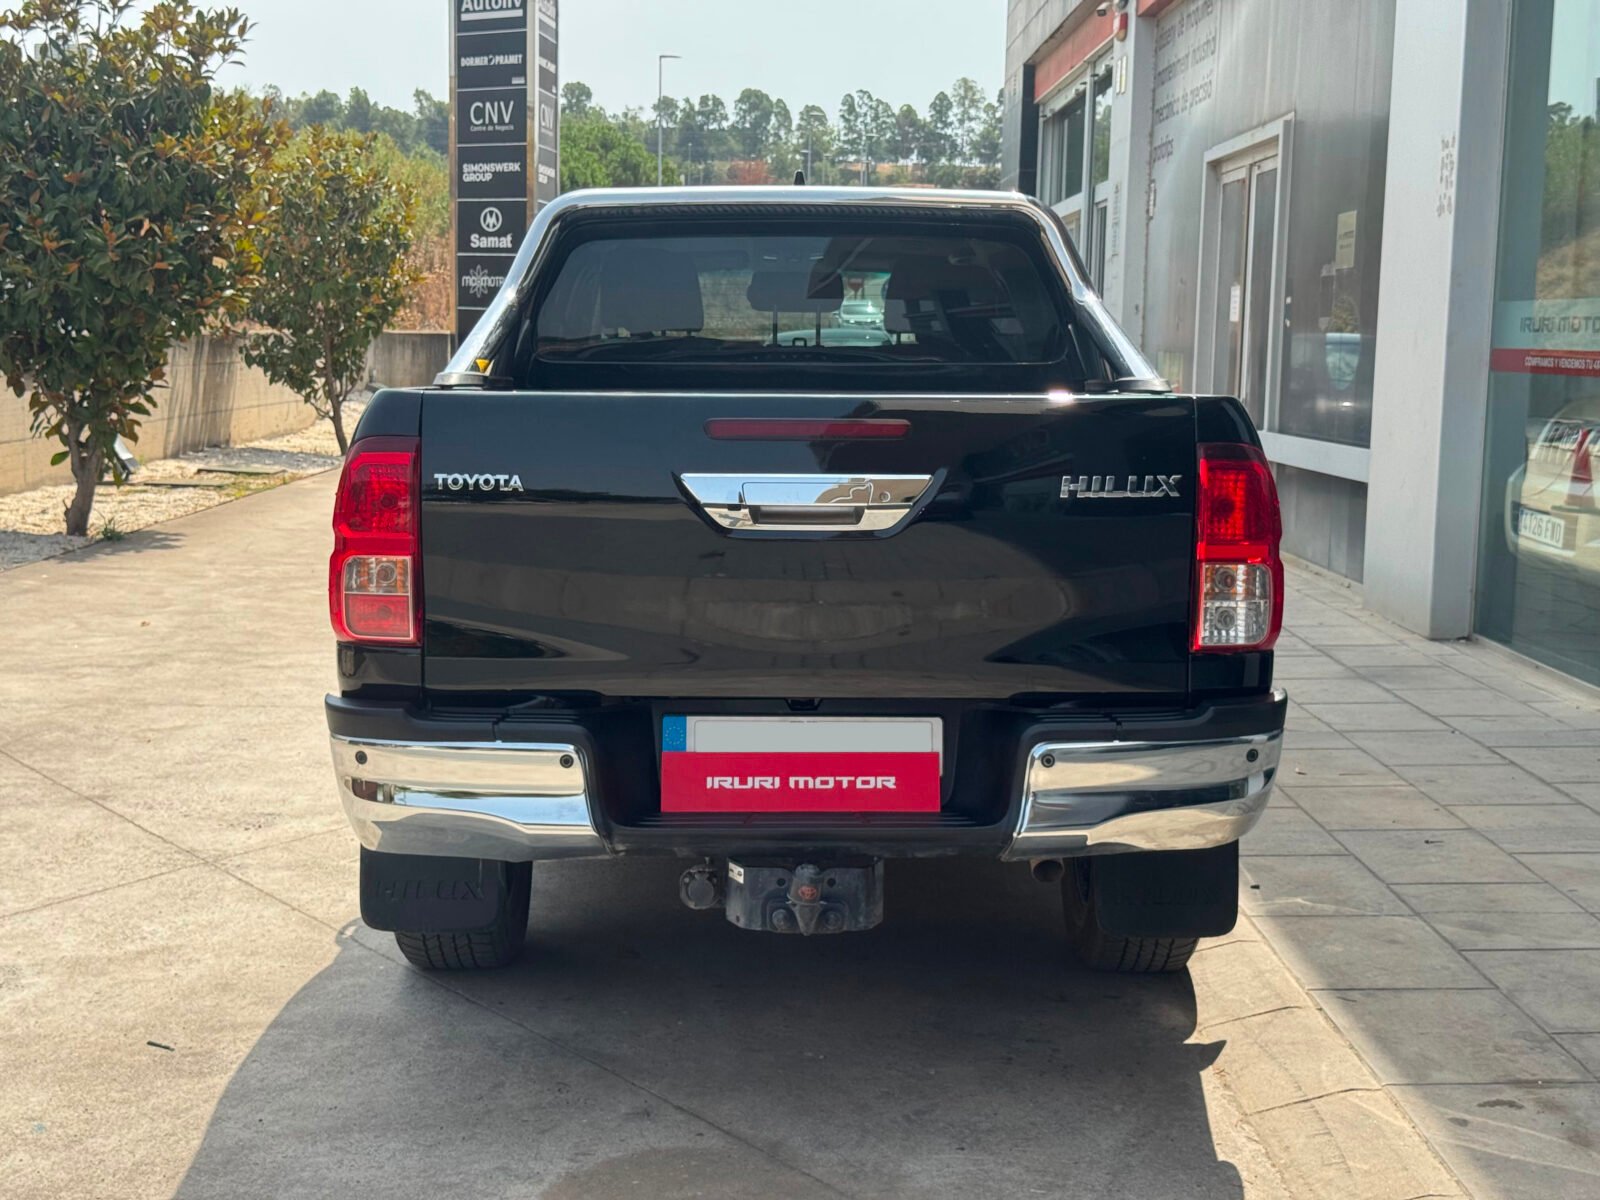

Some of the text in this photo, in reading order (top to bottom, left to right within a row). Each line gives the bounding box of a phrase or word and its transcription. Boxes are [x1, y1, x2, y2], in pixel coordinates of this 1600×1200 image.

[470, 100, 514, 125] CNV
[462, 162, 521, 173] SIMONSWERK
[462, 173, 493, 183] GROUP
[470, 233, 513, 248] Samat
[433, 473, 524, 492] TOYOTA
[1060, 475, 1182, 498] HILUX
[706, 776, 897, 789] IRURI MOTOR
[376, 879, 485, 899] HILUX
